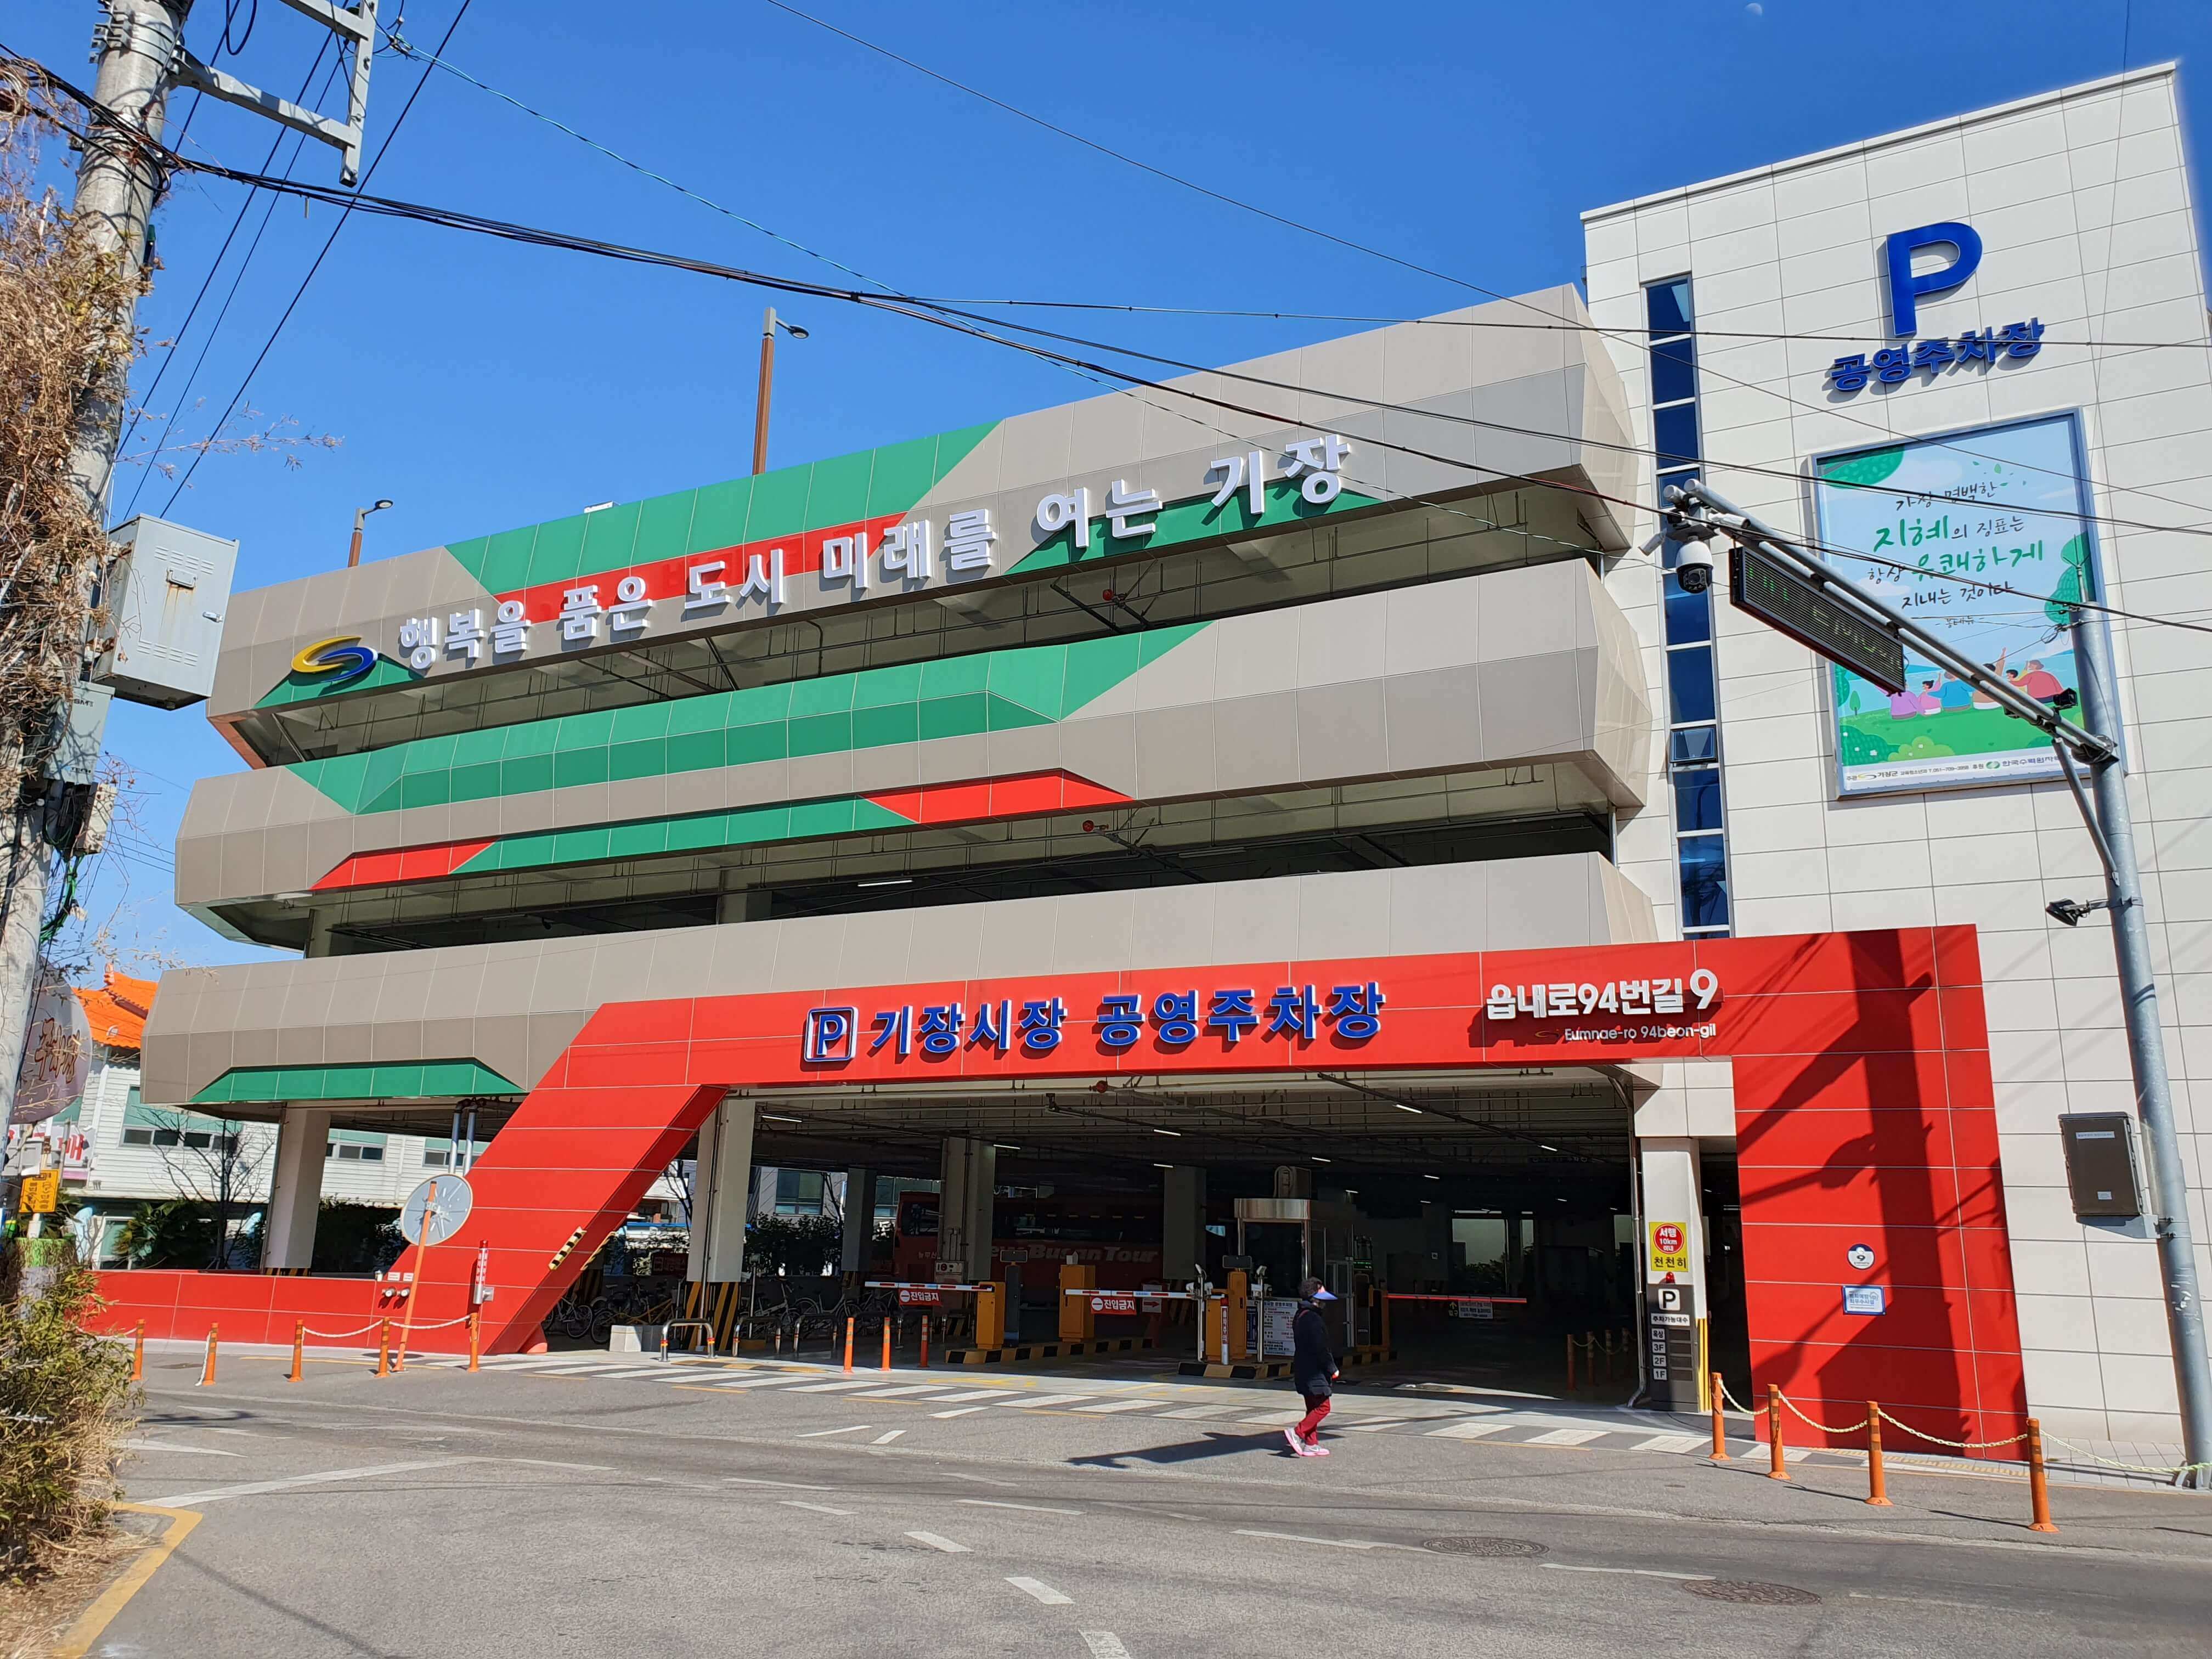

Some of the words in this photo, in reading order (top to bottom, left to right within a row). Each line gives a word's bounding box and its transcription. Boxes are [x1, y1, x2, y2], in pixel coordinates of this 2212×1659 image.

[1886, 222, 1983, 337] P
[1831, 317, 2045, 392] 공영주차장
[1897, 492, 1932, 511] 가장
[1945, 482, 1997, 503] 명백한
[1874, 515, 1967, 552] 지혜의
[1977, 516, 2024, 537] 징표는
[400, 600, 532, 669] 행복을
[560, 576, 653, 640] 품은
[685, 549, 785, 609] 도시
[823, 509, 998, 588] 미래를
[1037, 478, 1163, 548] 여는
[1211, 435, 1350, 514] 기장
[1867, 565, 1905, 584] 항상
[1912, 540, 2043, 582] 유쾌하게
[1901, 589, 1951, 610] 지내는
[1960, 582, 2015, 602] 것이다
[1486, 978, 1684, 1020] 읍내로94번길
[1690, 968, 1718, 1009] 9
[871, 996, 1068, 1054] 기장시장
[1097, 981, 1386, 1046] 공영주차장
[1565, 1028, 1637, 1041] Eumnae-ro
[1641, 1023, 1717, 1039] 94beon-gil
[817, 1014, 847, 1056] P
[1660, 1227, 1677, 1238] 서행
[1104, 1246, 1159, 1264] Tour
[1654, 1256, 1686, 1269] 천천히
[910, 1291, 939, 1301] 진입금지
[1103, 1299, 1135, 1311] 진입금지
[1663, 1290, 1676, 1308] P
